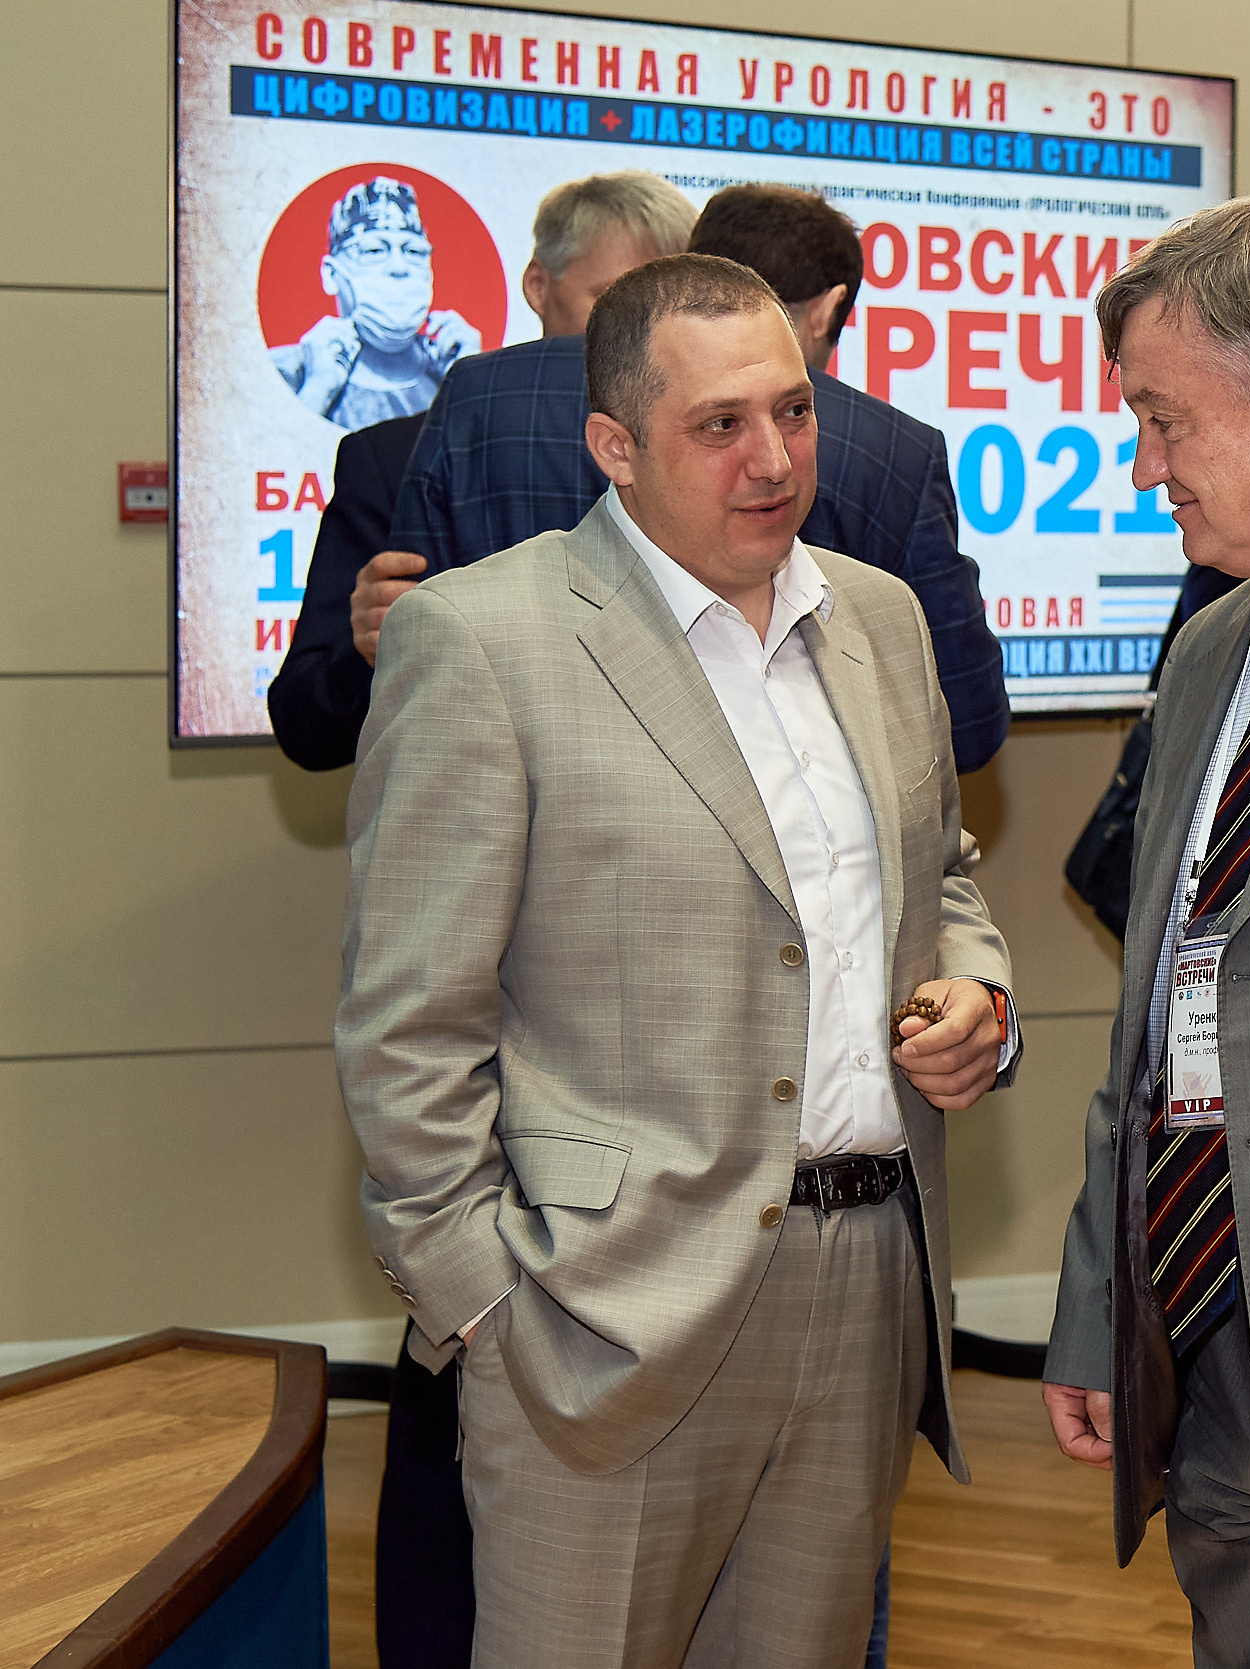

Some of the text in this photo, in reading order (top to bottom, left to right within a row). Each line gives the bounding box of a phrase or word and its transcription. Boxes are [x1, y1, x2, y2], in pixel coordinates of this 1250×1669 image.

[255, 11, 698, 96] СОВРЕМЕННАЯ
[739, 57, 1007, 123] УРОЛОГИЯ
[1088, 90, 1172, 137] ЭТО
[253, 73, 590, 138] ЦИФРОВИЗАЦИЯ
[630, 104, 943, 165] ЛАЗЕРОФИКАЦИЯ
[950, 131, 1034, 169] ВСЕЙ
[1039, 138, 1173, 181] СТРАНЫ
[859, 222, 1151, 300] ОВСКИ
[984, 597, 1084, 628] ОВАЯ
[1176, 971, 1216, 988] ВСТРЕЧИ
[1177, 1031, 1201, 1045] Сергей
[1184, 1098, 1212, 1113] VIP
